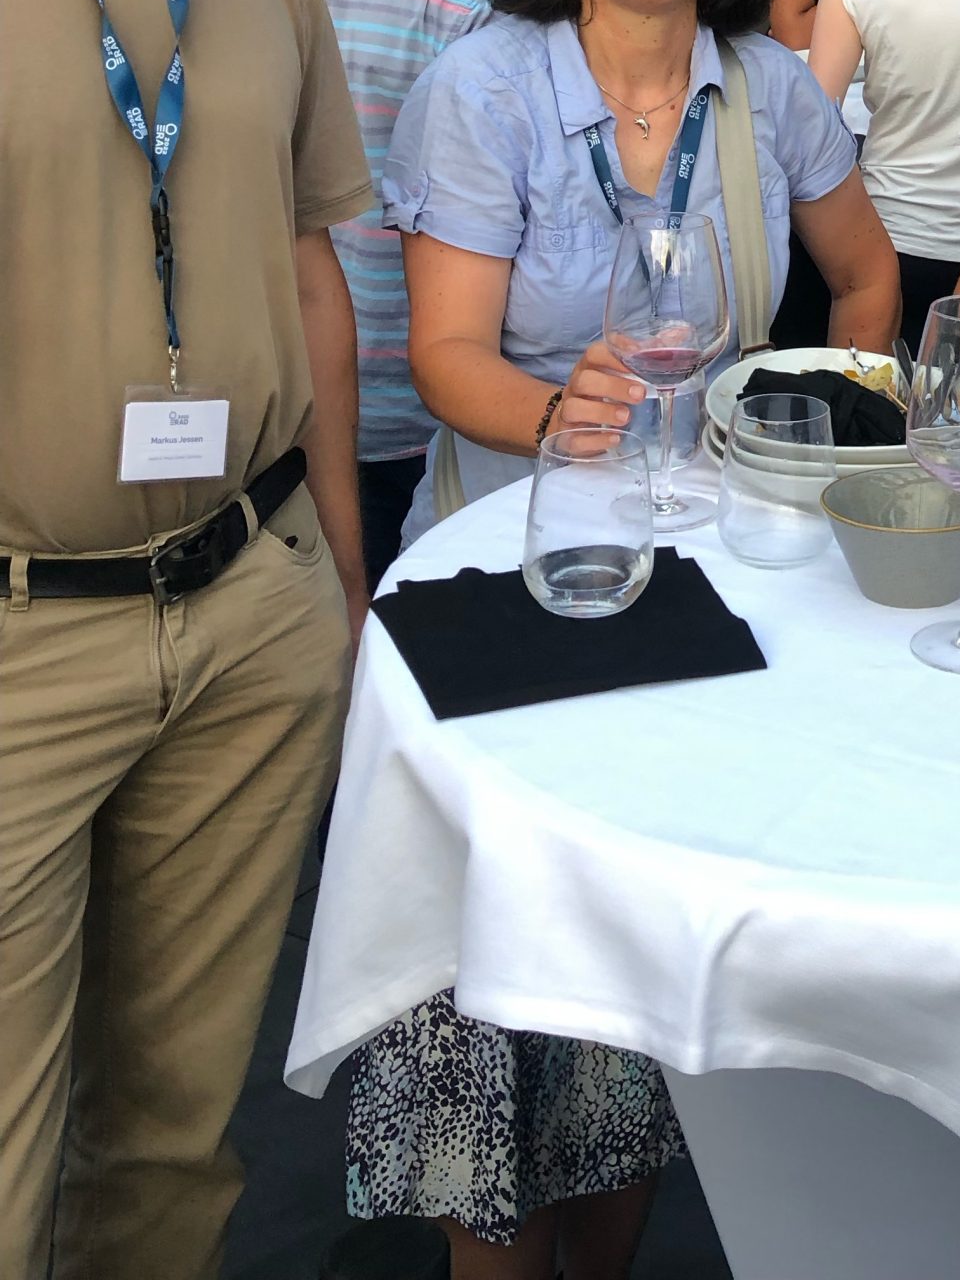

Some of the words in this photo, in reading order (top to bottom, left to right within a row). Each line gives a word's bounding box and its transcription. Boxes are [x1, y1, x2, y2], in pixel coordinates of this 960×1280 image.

[106, 36, 126, 66] ERAD
[154, 124, 166, 155] ERAD
[590, 127, 601, 146] ERA
[678, 152, 690, 178] ERAD
